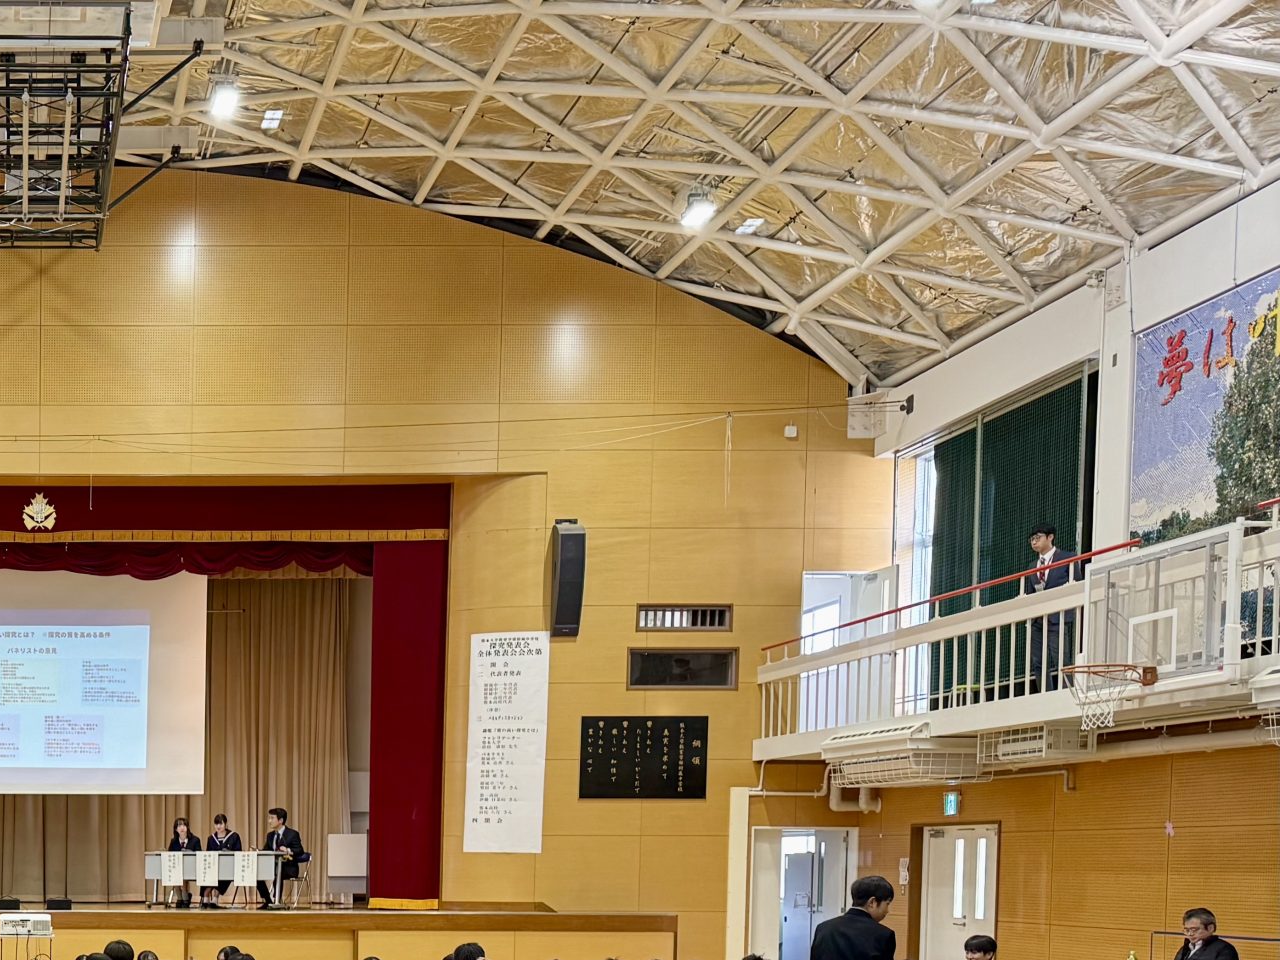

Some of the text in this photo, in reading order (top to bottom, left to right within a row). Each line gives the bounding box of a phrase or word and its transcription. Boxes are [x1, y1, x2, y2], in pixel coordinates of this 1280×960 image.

[489, 641, 530, 650] 探究発表会
[7, 647, 57, 655] パネリストの意見
[478, 648, 542, 658] 全体発表会会次第
